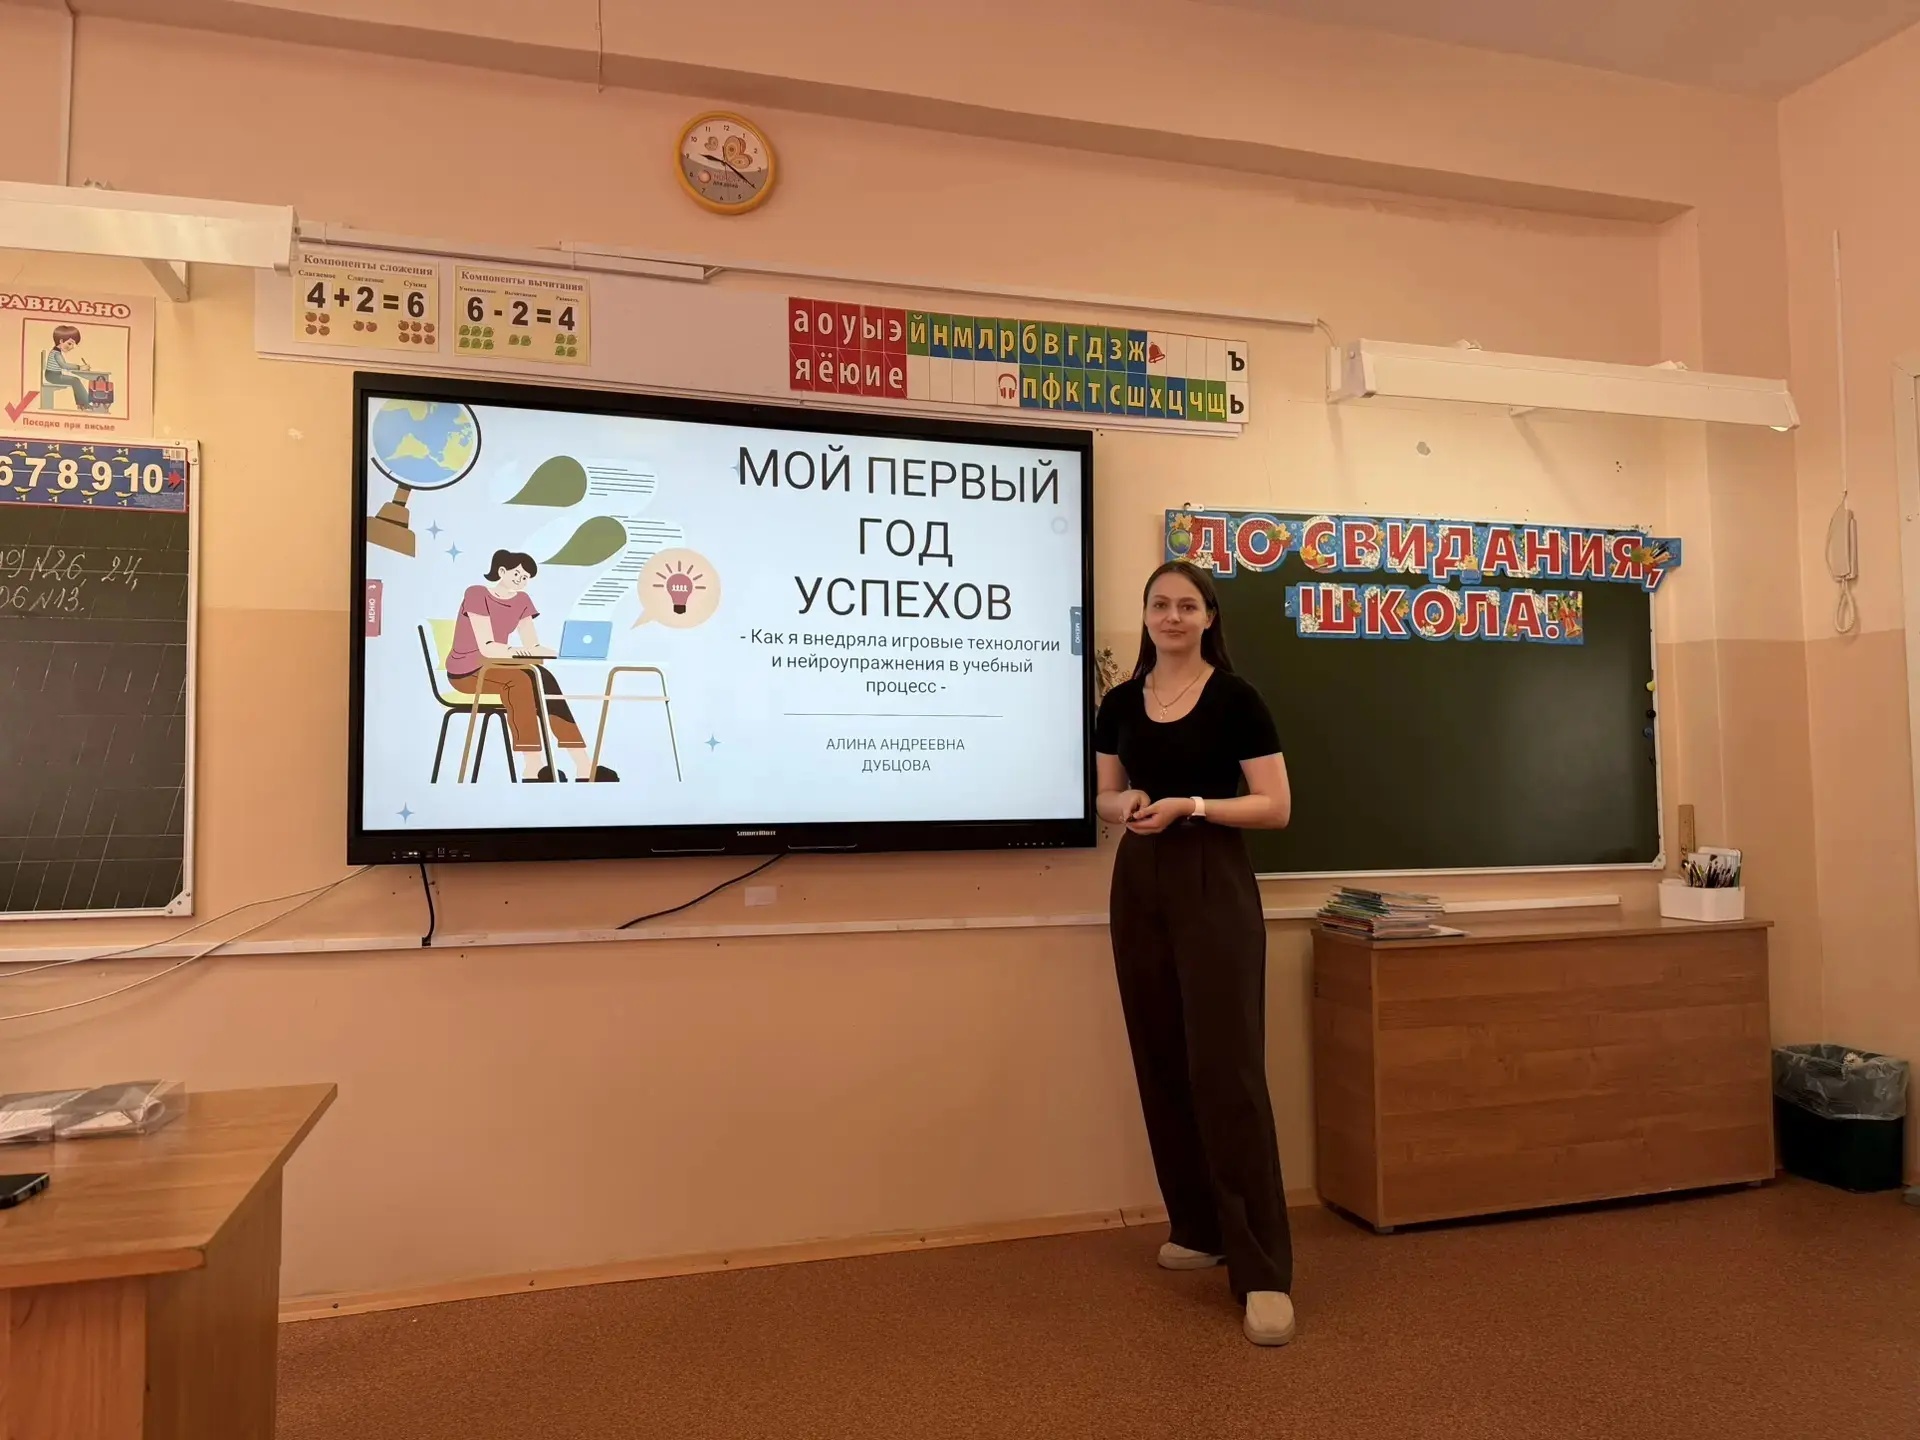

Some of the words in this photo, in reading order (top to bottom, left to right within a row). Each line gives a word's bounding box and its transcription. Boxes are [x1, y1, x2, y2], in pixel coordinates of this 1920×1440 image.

[303, 254, 377, 270] Компоненты
[380, 263, 433, 276] сложения
[298, 269, 336, 279] Слагаемое
[347, 274, 384, 284] Слагаемое
[403, 280, 427, 289] Сумма
[461, 271, 526, 285] Компоненты
[528, 278, 584, 291] вычитания
[306, 281, 326, 309] 4
[356, 286, 374, 313] 2
[407, 291, 425, 318] 6
[467, 296, 484, 322] 6
[512, 301, 529, 326] 2
[558, 306, 575, 331] 4
[22, 417, 60, 428] Посадка
[64, 421, 81, 430] при
[84, 423, 115, 432] письме
[15, 442, 28, 450] +1
[47, 444, 60, 452] +1
[116, 448, 129, 456] +1
[25, 458, 47, 488] 7
[57, 459, 79, 490] 8
[91, 461, 113, 491] 9
[124, 463, 164, 494] 10
[739, 444, 851, 492] МОЙ
[868, 456, 1060, 504] ПЕРВЫЙ
[16, 494, 27, 502] -1
[118, 499, 128, 507] -1
[859, 517, 953, 568] ГОД
[1184, 515, 1284, 574] ДО
[1302, 520, 1663, 588] СВИДАНИЯ,
[794, 575, 1012, 620] УСПЕХОВ
[368, 598, 376, 623] МЕНЮ
[1300, 586, 1560, 639] ШКОЛА!
[751, 628, 784, 644] Как
[788, 633, 798, 645] я
[803, 633, 887, 650] внедряла
[892, 636, 963, 651] игровые
[967, 638, 1060, 651] технологии
[772, 656, 782, 668] и
[787, 653, 945, 673] нейроупражнения
[949, 660, 959, 671] в
[963, 657, 1033, 675] учебный
[866, 681, 937, 696] процесс
[826, 738, 877, 750] АЛИНА
[880, 738, 965, 752] АНДРЕЕВНА
[861, 759, 931, 773] ДУБЦОВА
